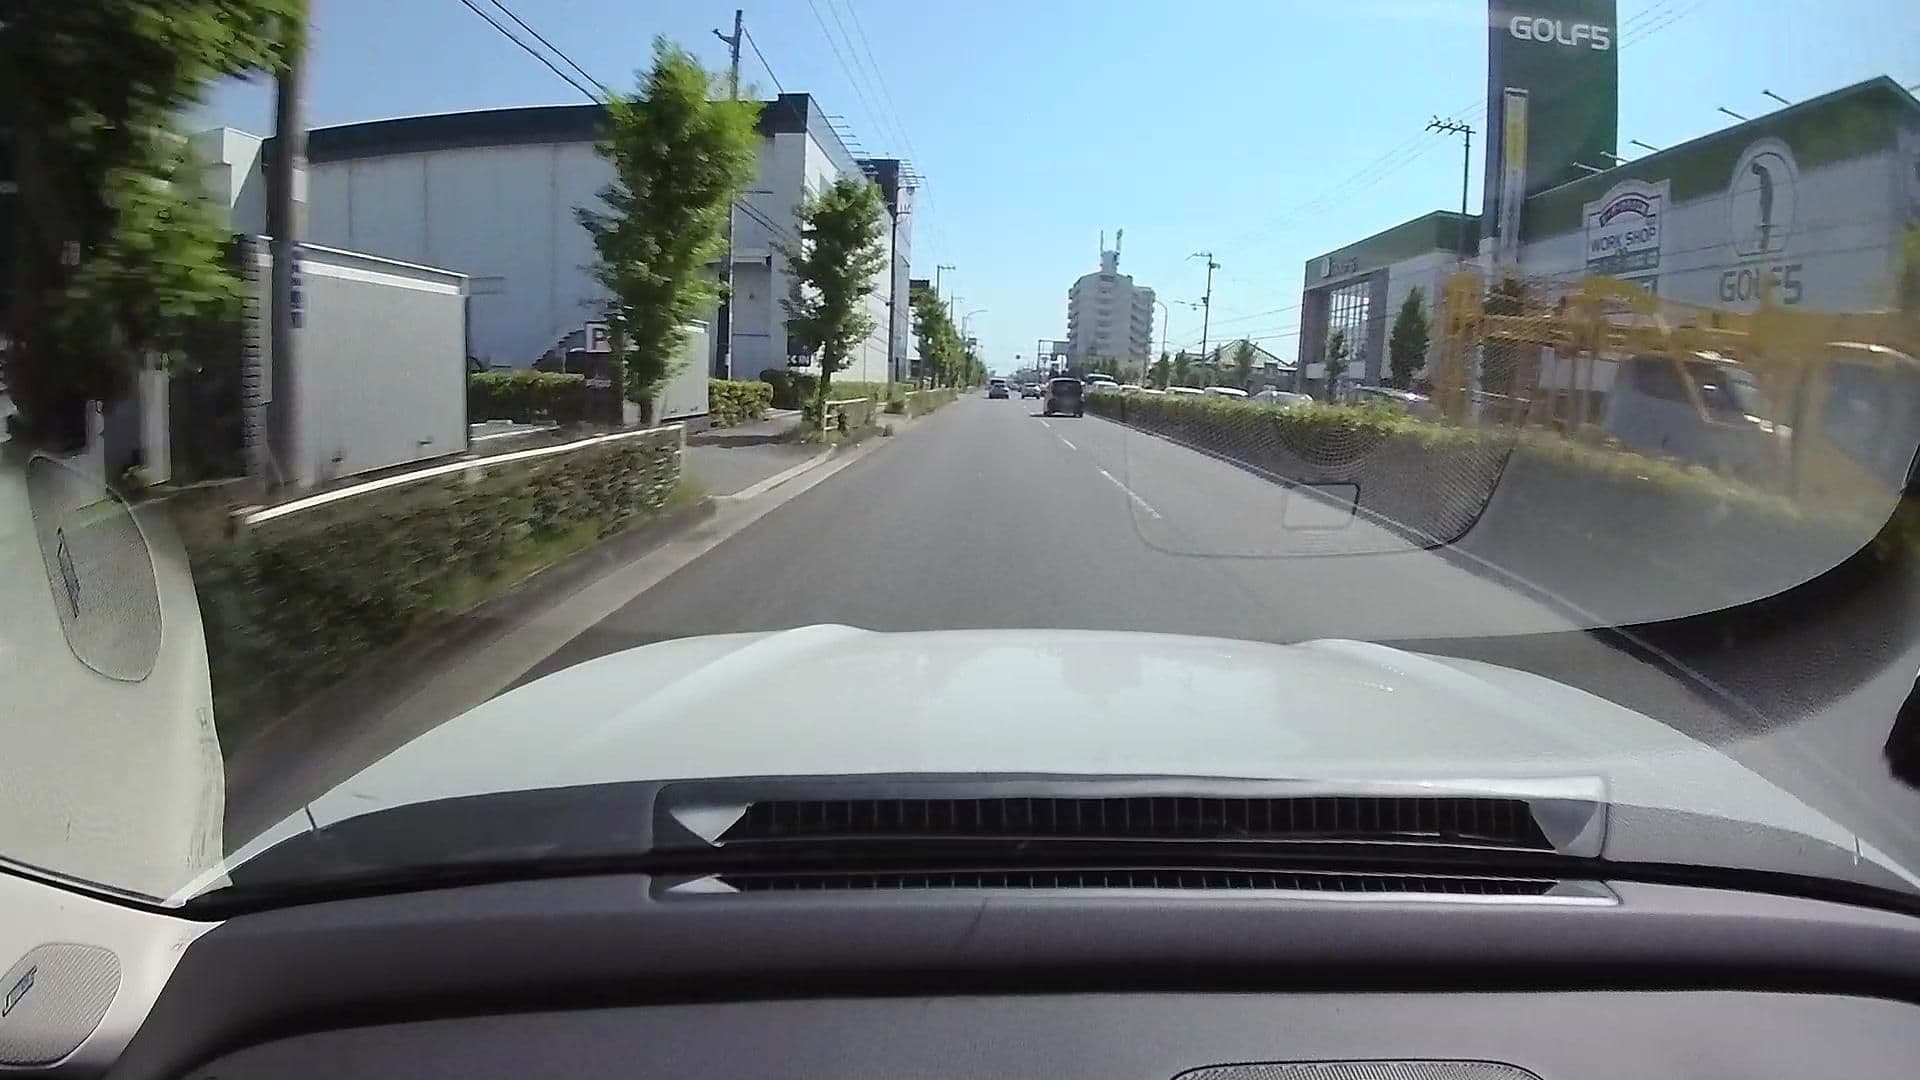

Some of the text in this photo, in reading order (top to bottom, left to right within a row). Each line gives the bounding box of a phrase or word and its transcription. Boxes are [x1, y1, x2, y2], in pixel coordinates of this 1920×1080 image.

[1510, 16, 1610, 51] GOLF5
[1592, 227, 1656, 252] WORK SHOP
